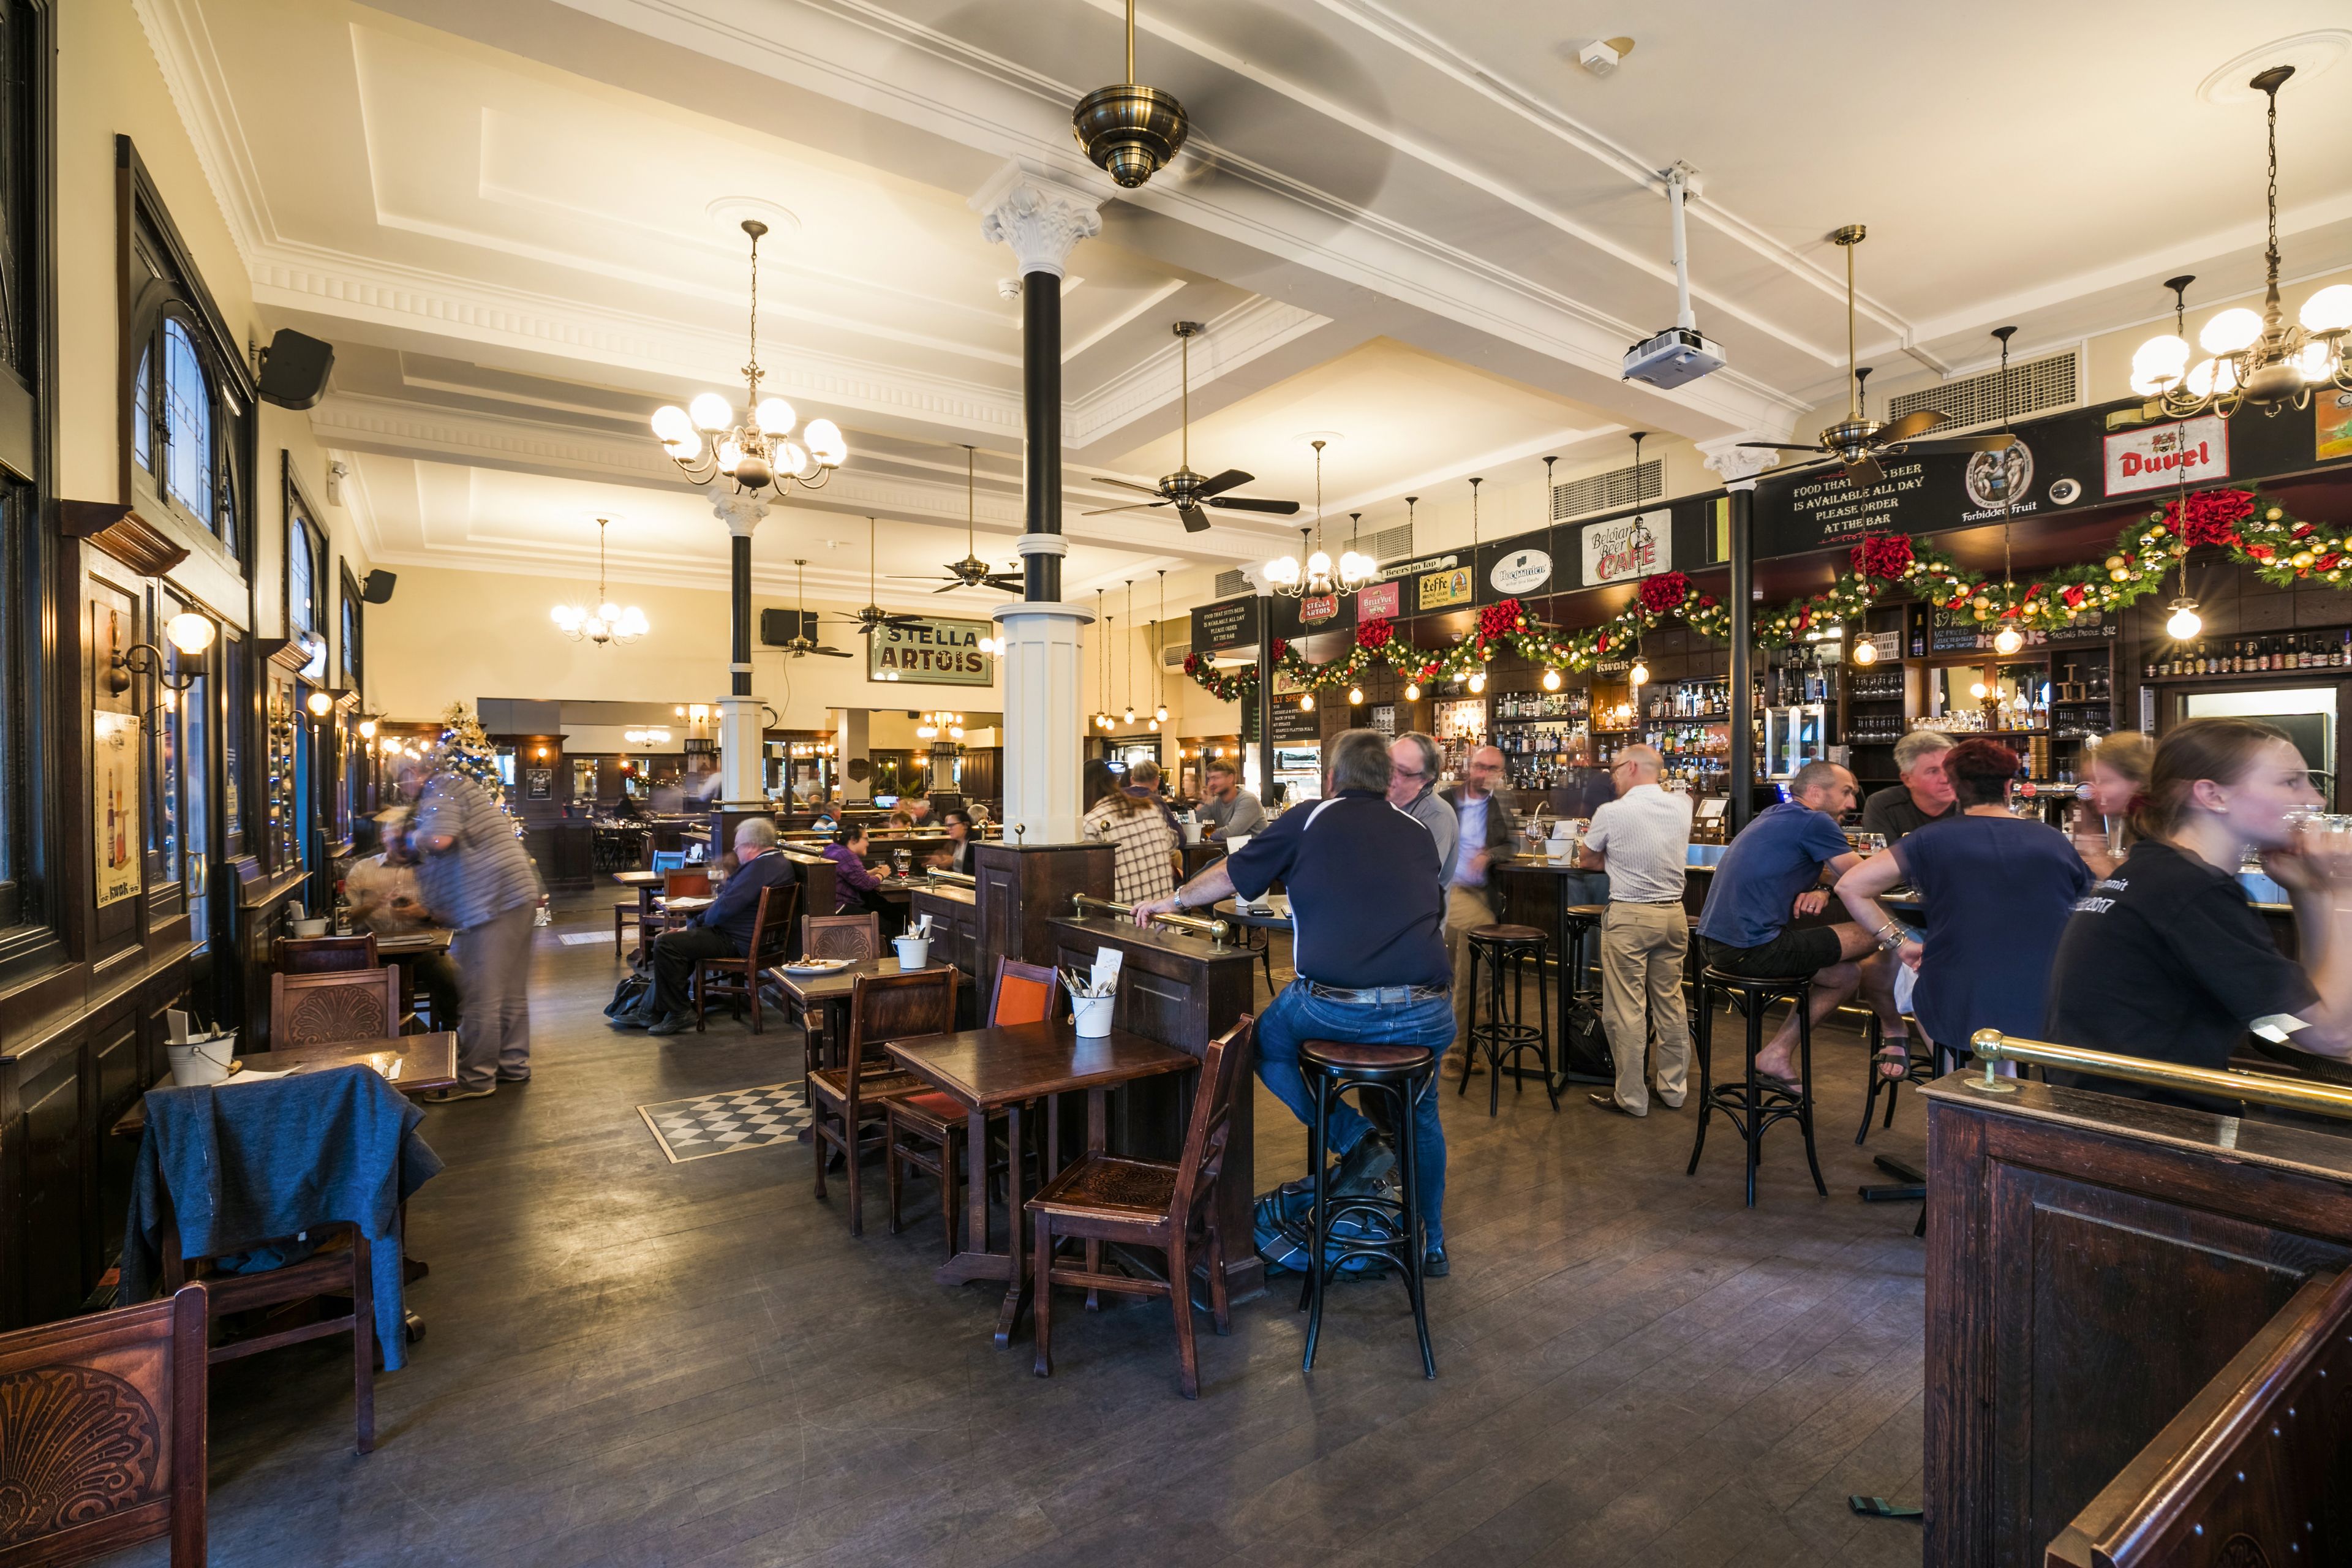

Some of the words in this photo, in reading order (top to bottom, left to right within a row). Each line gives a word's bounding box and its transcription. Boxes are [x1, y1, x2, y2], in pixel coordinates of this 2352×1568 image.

[2119, 441, 2210, 477] Duvel
[1793, 484, 1822, 498] FOOD
[1823, 478, 1852, 492] THAT
[1890, 464, 1923, 478] BEER
[1793, 502, 1804, 511] IS
[1806, 488, 1870, 510] AVAILABLE
[1872, 484, 1895, 496] ALL
[1898, 476, 1926, 491] DAY
[1816, 505, 1858, 521] PLEASE
[1861, 497, 1899, 511] ORDER
[2011, 501, 2037, 514] Fruit
[1824, 522, 1839, 534] AT
[1841, 519, 1863, 530] THE
[1866, 514, 1891, 526] BAR
[1592, 526, 1632, 549] Belgian
[1599, 540, 1626, 559] Beer
[1386, 566, 1409, 576] Beers
[1422, 560, 1436, 568] Tap
[1423, 576, 1448, 593] Leffe
[1306, 600, 1330, 609] STELLA
[1306, 607, 1331, 617] ARTOIS
[1208, 618, 1229, 627] AVAILABLE
[1934, 612, 1950, 628] $9
[888, 627, 978, 647] STELLA
[1975, 630, 2048, 648] KK
[2102, 625, 2116, 636] $12
[880, 647, 983, 673] ARTOIS
[2086, 897, 2116, 913] 2017
